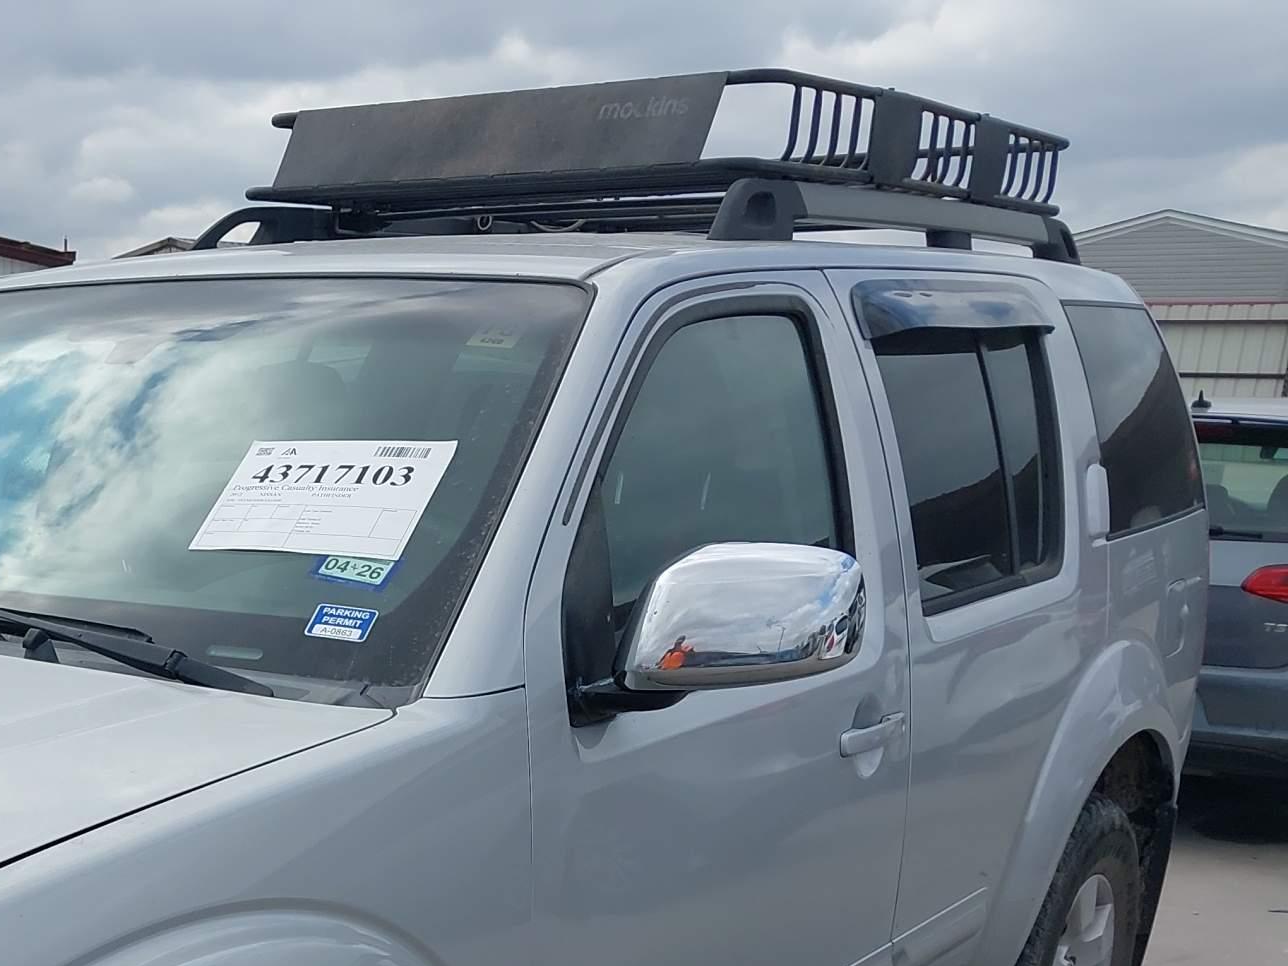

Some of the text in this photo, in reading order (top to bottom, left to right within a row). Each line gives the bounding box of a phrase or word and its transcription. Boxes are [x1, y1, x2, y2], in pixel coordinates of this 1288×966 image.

[250, 464, 415, 487] 43717103
[232, 484, 280, 492] Progressive
[322, 607, 370, 620] PARKING
[321, 616, 363, 628] PERMIT
